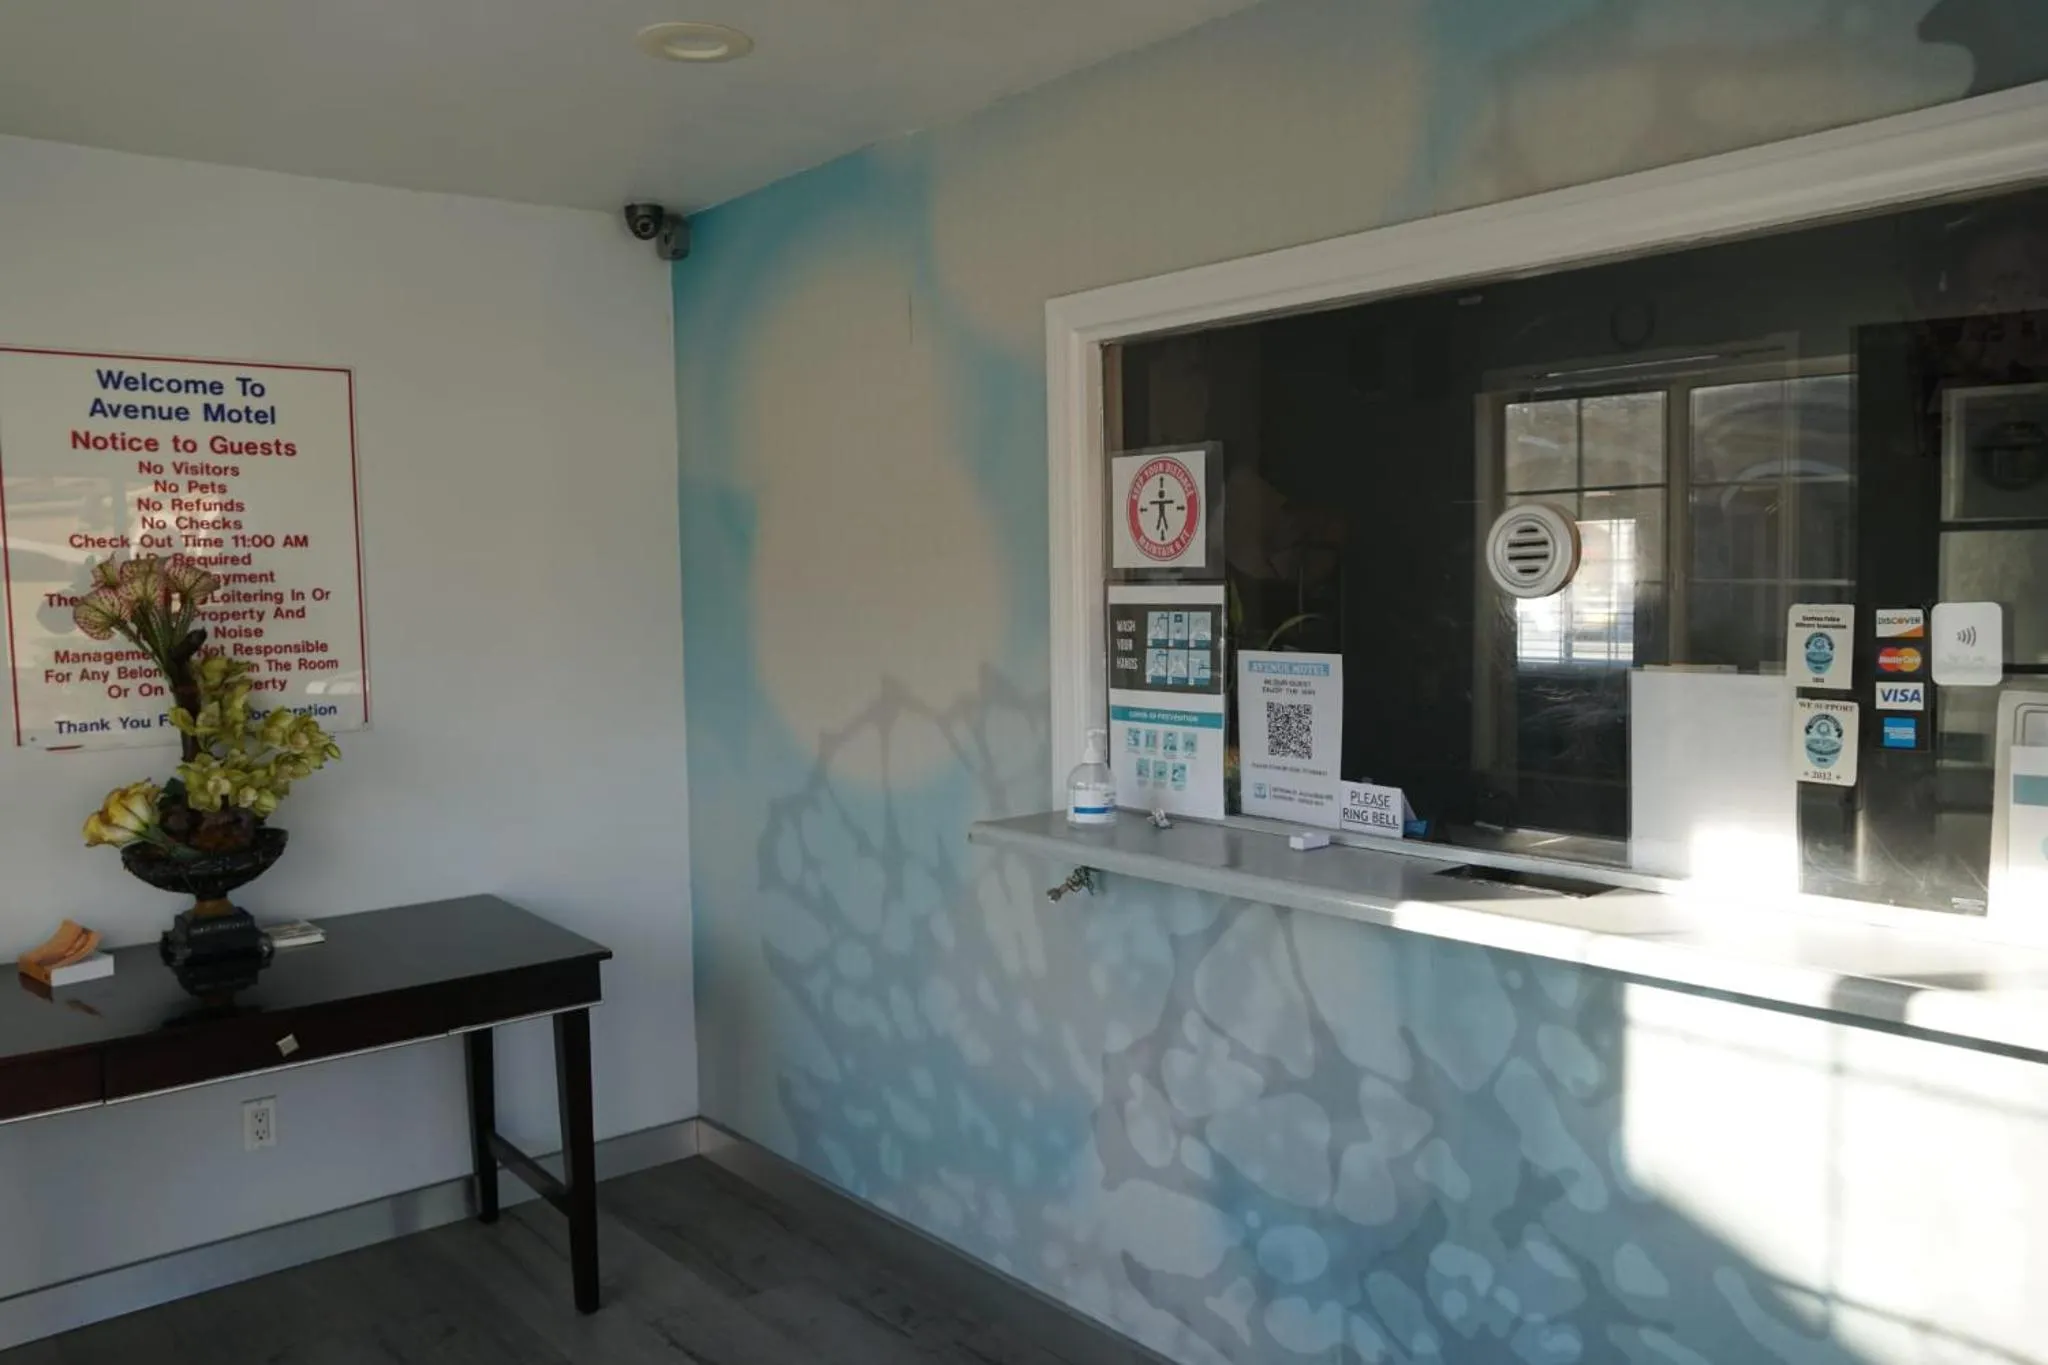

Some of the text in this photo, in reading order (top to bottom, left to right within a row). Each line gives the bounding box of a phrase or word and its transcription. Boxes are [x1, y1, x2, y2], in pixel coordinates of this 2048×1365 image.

[96, 369, 266, 398] Welcome To
[89, 398, 275, 425] Avenue Motel
[71, 430, 297, 457] Notice to Guests
[138, 461, 240, 476] No Visitors
[154, 480, 227, 494] No Pets
[137, 498, 245, 512] No Refunds
[141, 516, 242, 530] No Checks
[69, 534, 309, 549] Check Out Time 11:00 AM
[172, 553, 252, 568] Required
[213, 571, 275, 587] ayment
[211, 588, 284, 604] Loitering
[290, 588, 306, 601] In
[312, 588, 331, 601] Or
[274, 606, 305, 619] And
[1878, 616, 1921, 625] DISCOVER
[214, 625, 264, 639] Noise
[54, 650, 153, 665] Manageme
[233, 641, 328, 657] Responsible
[1879, 655, 1921, 665] MasterCard
[44, 670, 72, 683] For
[79, 668, 109, 683] Any
[266, 659, 292, 672] The
[298, 657, 339, 670] Room
[107, 684, 130, 698] Or
[138, 683, 164, 697] On
[1881, 689, 1921, 703] VISA
[55, 717, 110, 734] Thank
[119, 716, 151, 729] You
[1350, 791, 1391, 807] PLEASE
[1342, 807, 1398, 826] RING BELL
